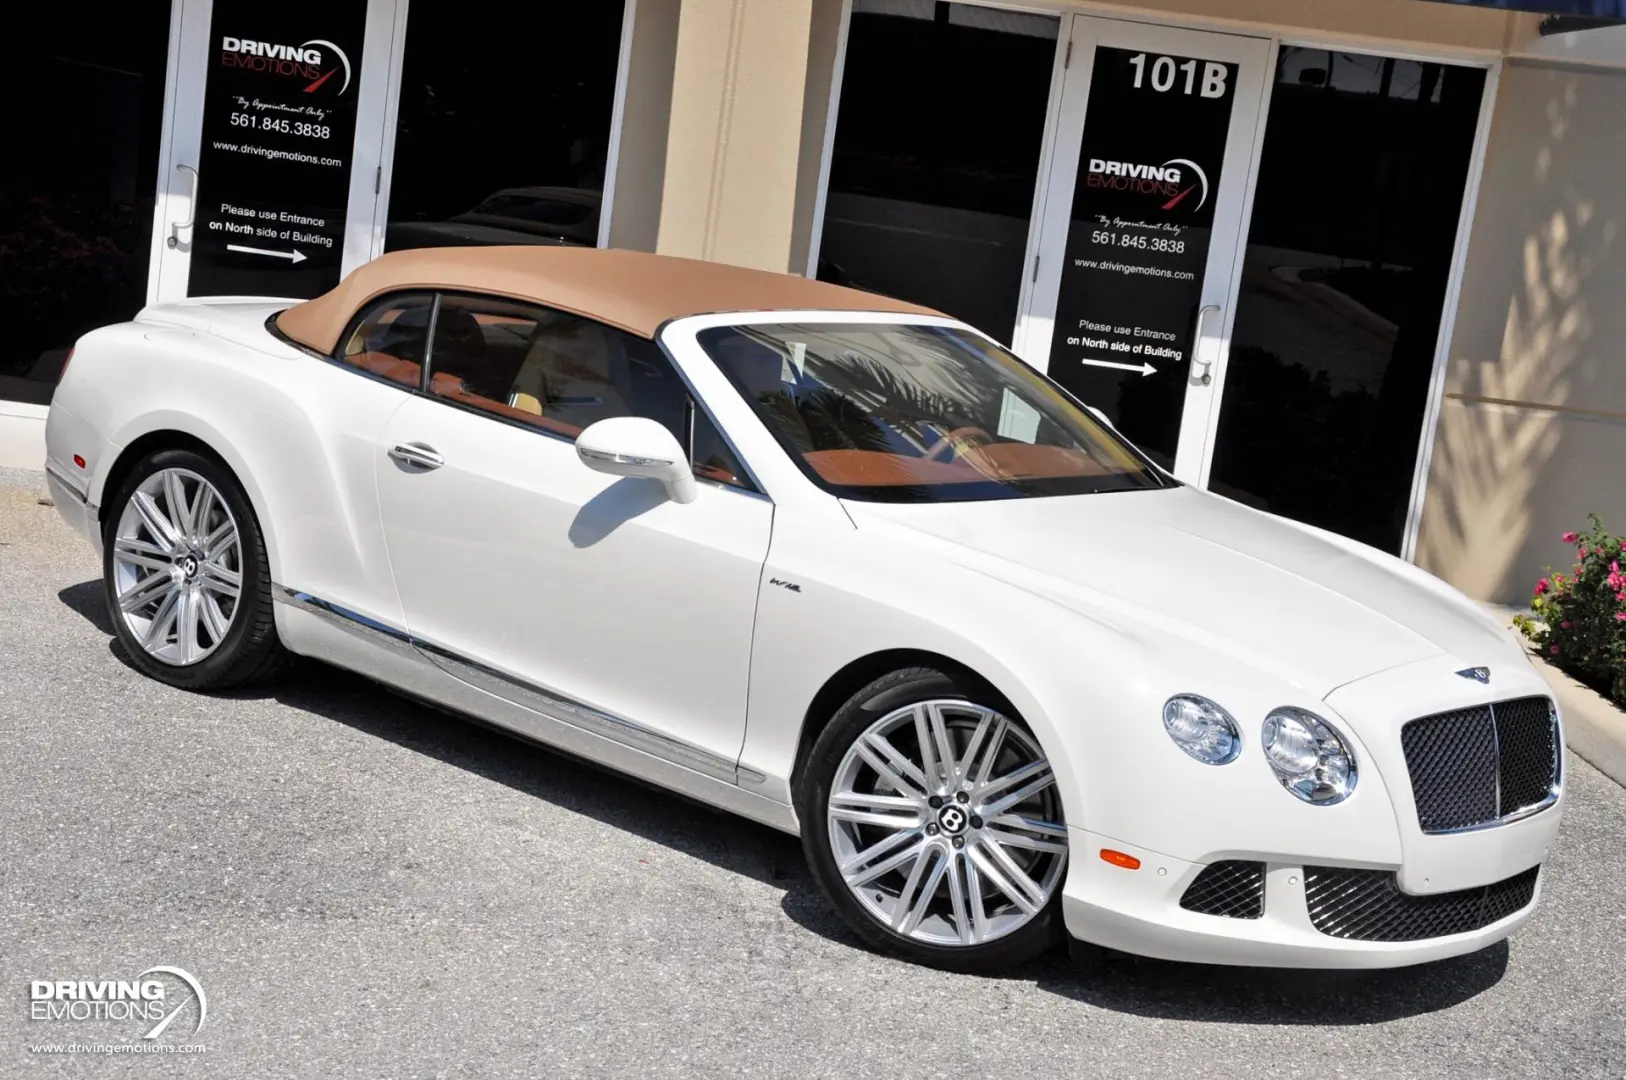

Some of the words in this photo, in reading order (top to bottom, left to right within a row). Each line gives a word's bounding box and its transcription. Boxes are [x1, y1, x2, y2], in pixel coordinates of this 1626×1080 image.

[222, 36, 321, 65] DRIVING
[221, 52, 320, 80] EMOTIONS
[1129, 53, 1228, 99] 101B
[252, 98, 305, 113] Appointment
[230, 112, 331, 140] 561.845.3838
[213, 141, 342, 168] www.drivingemotions.com
[1088, 158, 1182, 183] DRIVING
[1087, 173, 1179, 197] EMOTIONS
[220, 203, 256, 218] Please
[258, 210, 277, 221] use
[280, 212, 325, 227] Entrance
[1113, 216, 1162, 229] Appointment
[209, 221, 223, 231] on
[225, 221, 254, 235] North
[256, 226, 278, 239] side
[280, 230, 291, 241] of
[292, 231, 333, 248] Building
[1091, 231, 1185, 254] 561.845.3838
[1074, 259, 1195, 280] www.drivingemotions.com
[1079, 319, 1111, 333] Please
[1113, 326, 1131, 335] use
[1133, 327, 1176, 341] Entrance
[1067, 336, 1080, 346] on
[1081, 337, 1109, 349] North
[1110, 341, 1131, 352] side
[1132, 344, 1143, 354] of
[1144, 345, 1182, 361] Building
